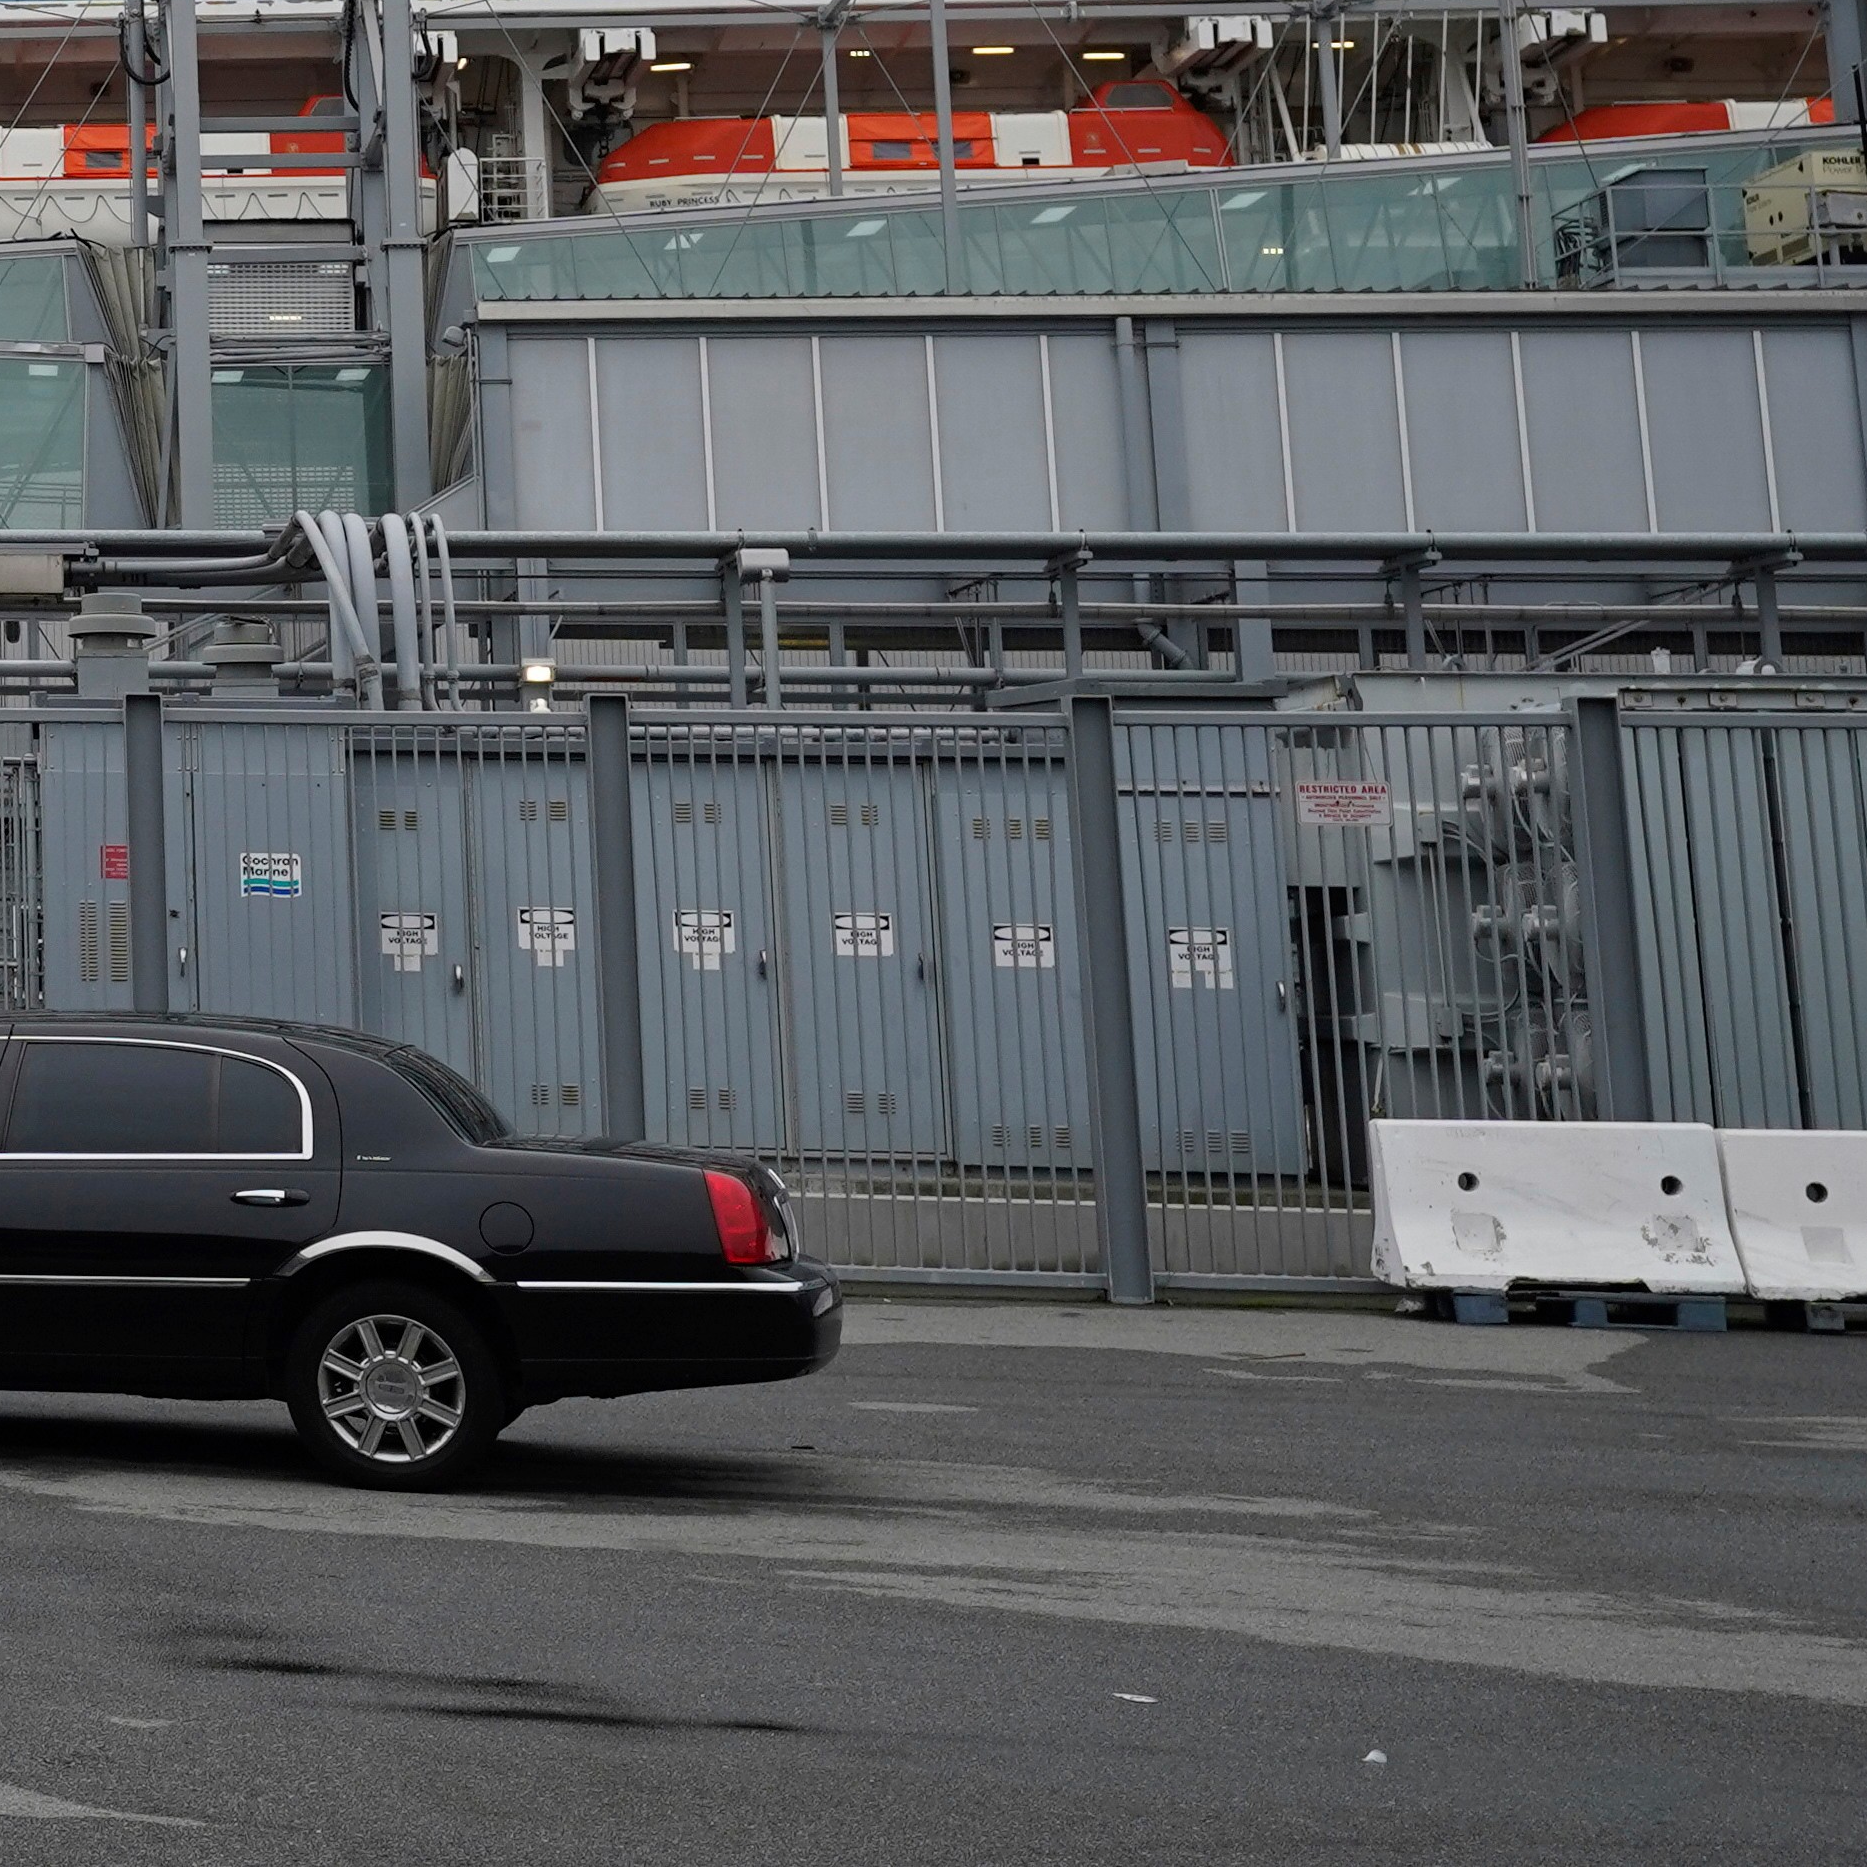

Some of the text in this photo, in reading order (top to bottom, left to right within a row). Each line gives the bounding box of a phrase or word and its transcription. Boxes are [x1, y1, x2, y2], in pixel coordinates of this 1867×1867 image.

[1822, 156, 1861, 165] KOHLER
[649, 195, 720, 208] RUBY PRINCESS
[1299, 785, 1387, 794] RESTRICTED AREA
[242, 855, 299, 866] Cochran
[242, 866, 289, 876] Marne
[529, 932, 569, 940] OLTGE
[684, 935, 723, 943] VOTAG
[1178, 953, 1218, 961] VOTAG
